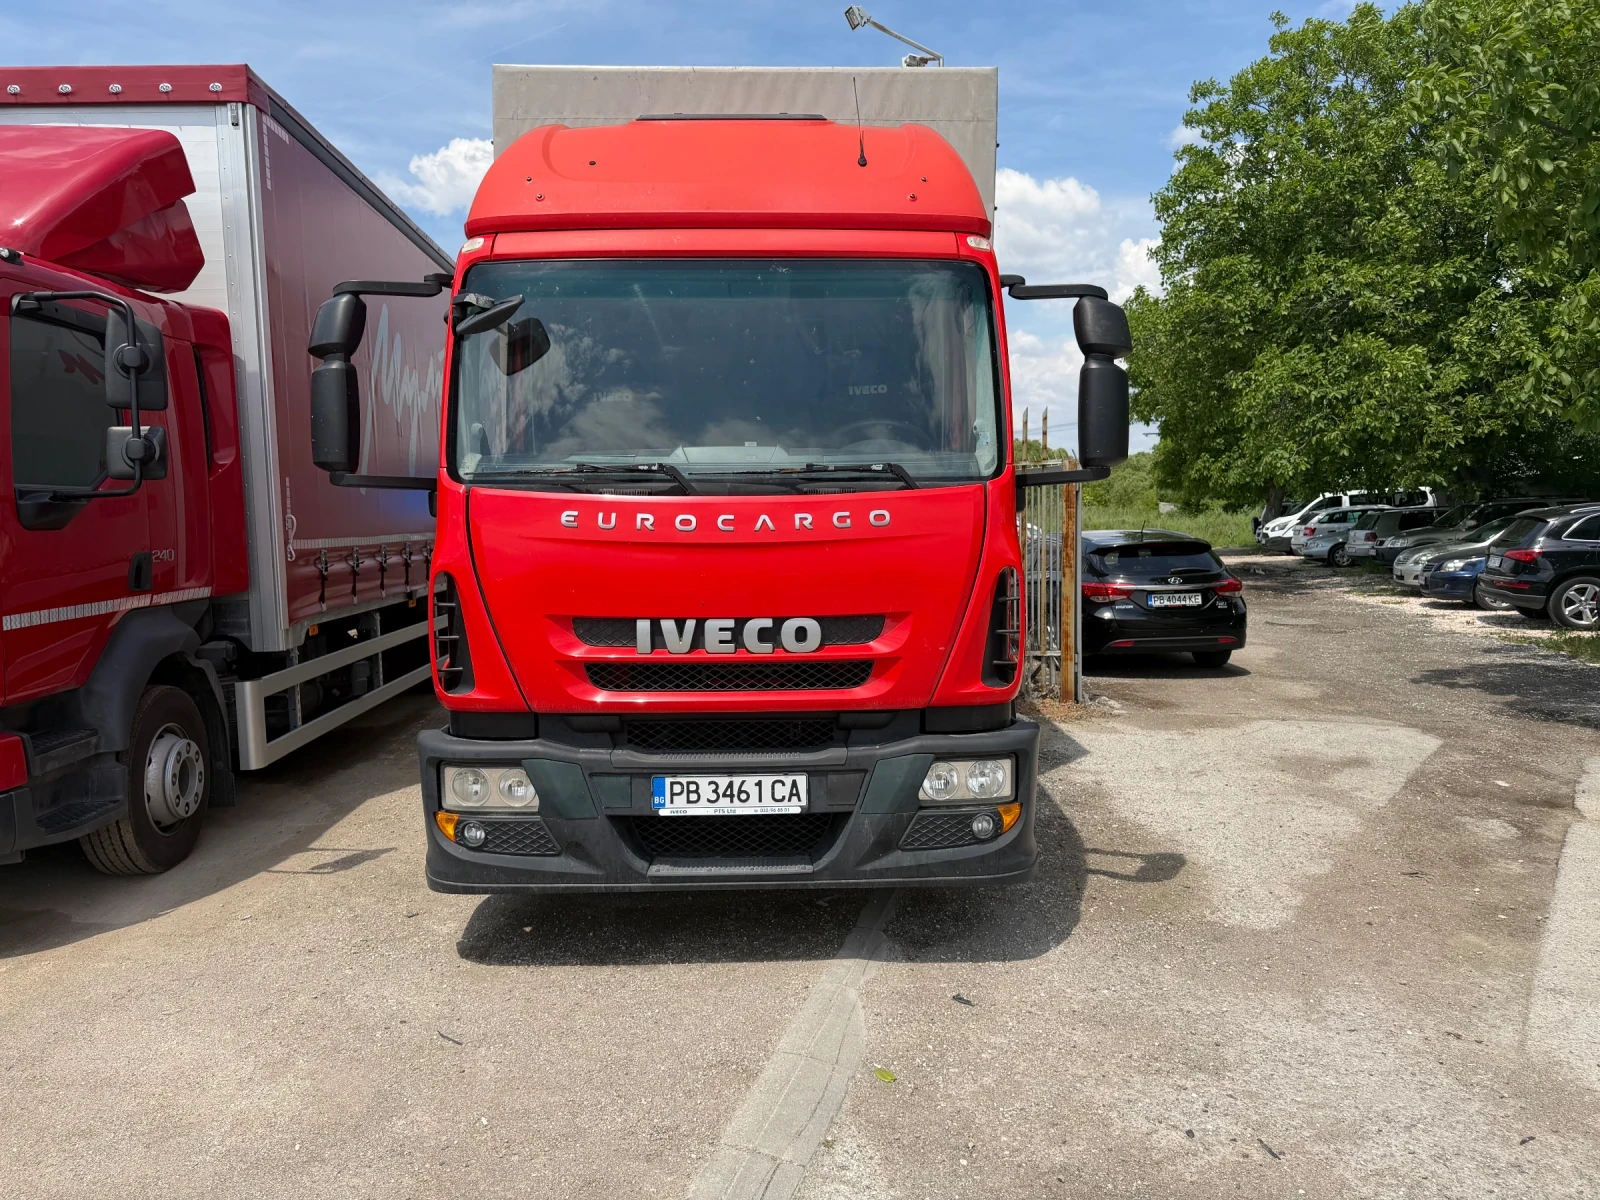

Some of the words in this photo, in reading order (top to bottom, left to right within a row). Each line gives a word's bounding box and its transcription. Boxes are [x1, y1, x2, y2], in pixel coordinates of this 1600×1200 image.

[847, 384, 888, 396] IVECO
[560, 509, 892, 532] EUROCARGO
[151, 548, 175, 563] 240
[1153, 595, 1165, 605] PB
[1166, 594, 1187, 604] 4044
[1188, 594, 1201, 604] KE
[635, 617, 823, 655] IVECO
[669, 780, 702, 805] PB
[706, 779, 764, 804] 3461
[770, 779, 802, 803] CA
[654, 796, 665, 805] BG
